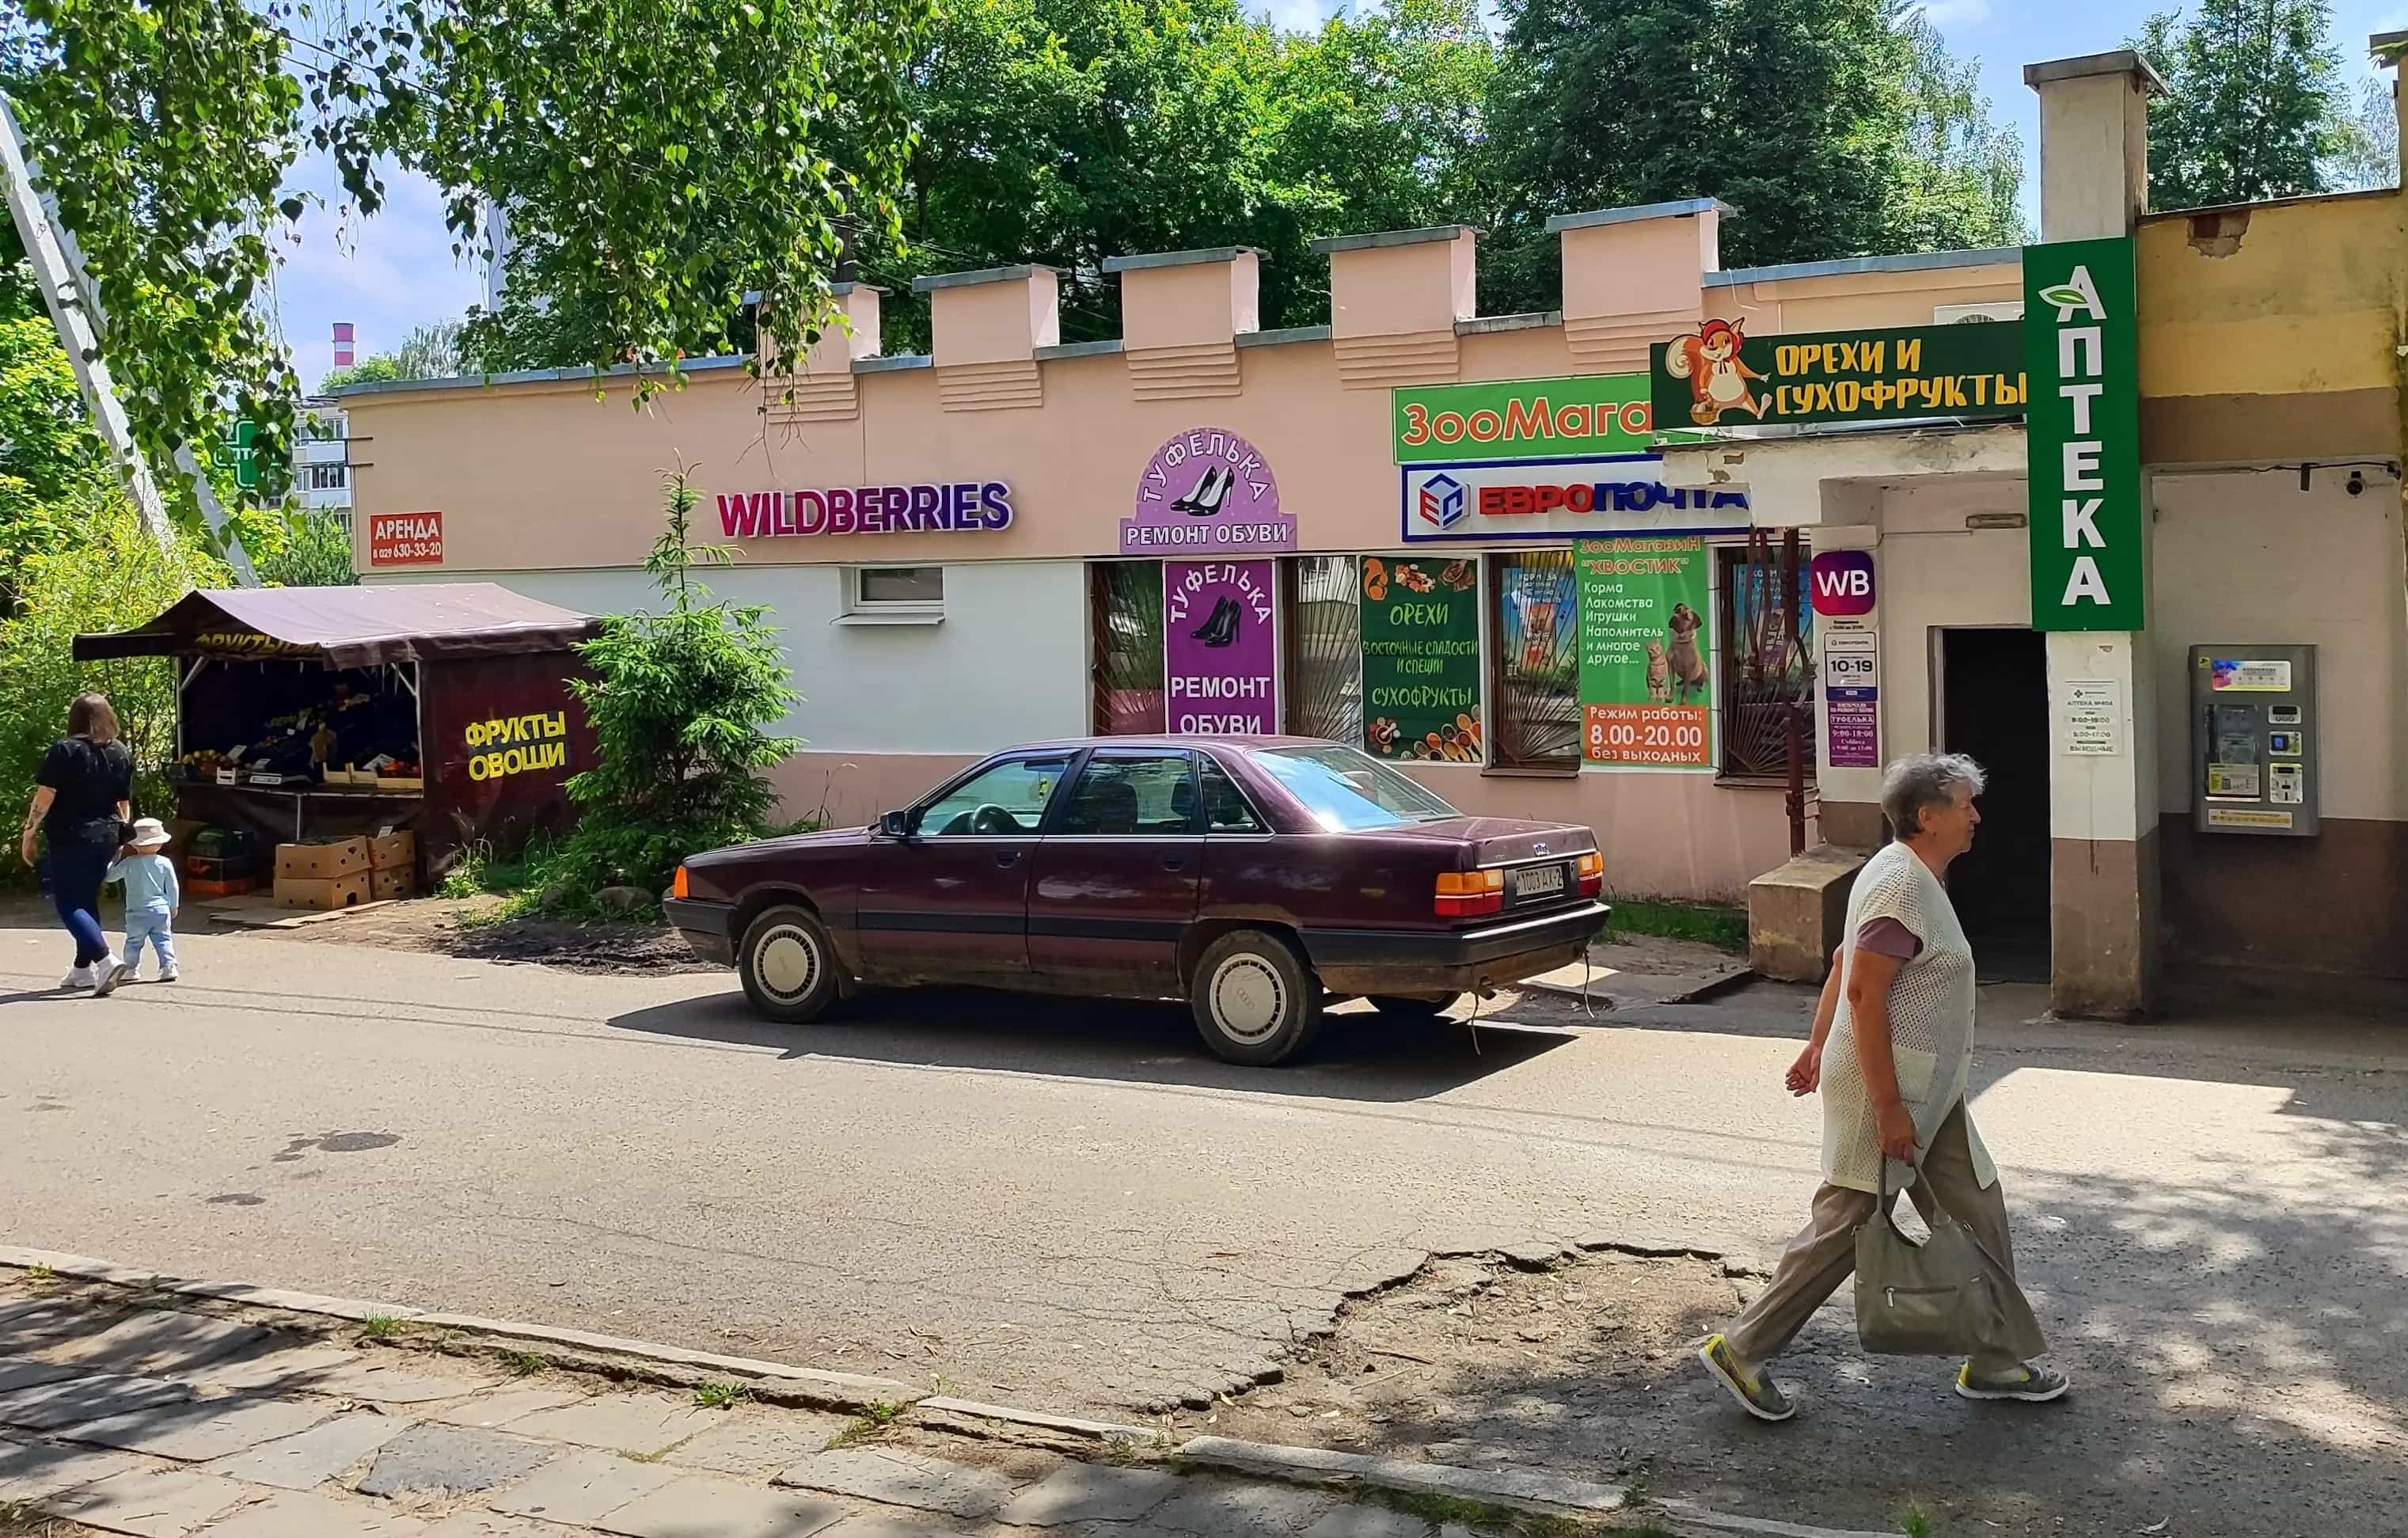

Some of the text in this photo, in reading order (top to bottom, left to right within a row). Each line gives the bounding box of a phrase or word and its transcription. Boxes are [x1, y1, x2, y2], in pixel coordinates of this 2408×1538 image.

[1775, 339, 1922, 376] ОРЕХИ И
[1775, 372, 2026, 415] СУХОФРУКТЫ
[2056, 265, 2112, 606] АПТЕКА
[1142, 432, 1270, 502] ТУФЕЛЬКА
[716, 481, 1014, 538] WILDBERRIES
[375, 518, 439, 540] АРЕНДА
[1126, 523, 1287, 545] РЕМОНТ ОБУВИ
[379, 549, 392, 557] 029
[394, 542, 442, 557] 630-33-20
[1584, 581, 1624, 595] Корма
[1816, 570, 1870, 597] WB
[1170, 564, 1271, 625] ТУФЕЛЬКА
[1585, 597, 1653, 609] Лакомства
[1389, 602, 1449, 625] ОРЕХИ
[1586, 610, 1636, 624] Игрушки
[1586, 625, 1664, 637] Наполнитель
[1362, 640, 1478, 655] ВОСТОЧНЫЕ СЛАДОСТИ
[1586, 642, 1641, 652] и многое
[1396, 659, 1443, 675] И СПЕЦИИ
[1586, 654, 1639, 666] другое...
[1830, 660, 1873, 672] 10-19
[1171, 677, 1270, 698] РЕМОНТ
[1372, 685, 1472, 708] СУХОФРУКТЫ
[1179, 714, 1261, 735] ОБУВИ
[1590, 707, 1702, 722] Режим работы:
[465, 711, 566, 746] ФРУКТЫ
[1590, 724, 1702, 746] 8.00-20.00
[469, 742, 565, 780] ОВОЩИ
[1591, 746, 1701, 762] без выходных
